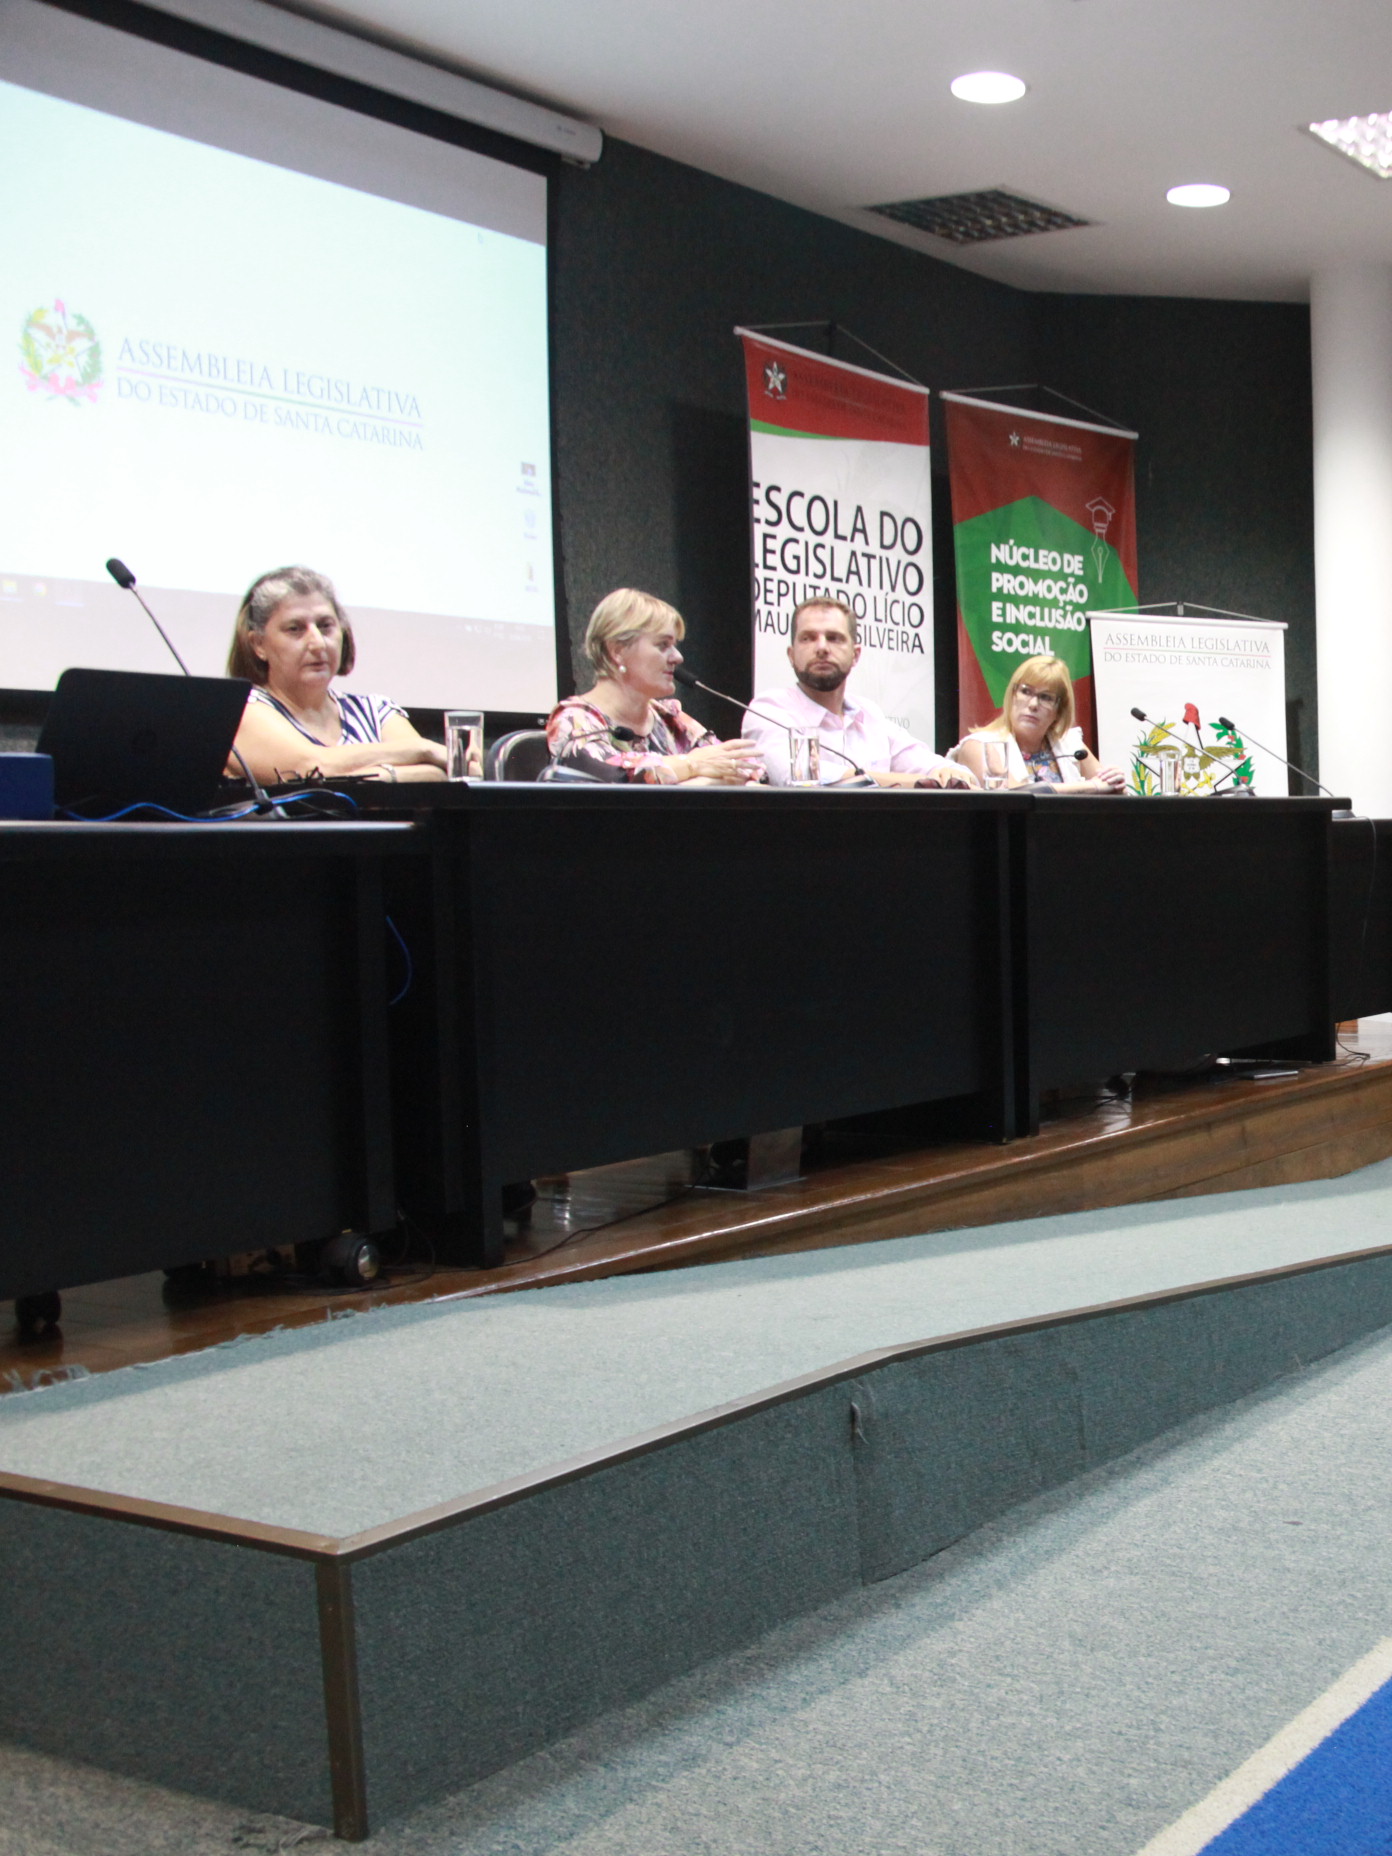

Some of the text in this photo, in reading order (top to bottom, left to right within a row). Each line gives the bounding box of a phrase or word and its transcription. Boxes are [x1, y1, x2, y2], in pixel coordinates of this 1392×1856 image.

[117, 337, 422, 419] ASSEMBLEIA LEGISLATIVA
[117, 376, 423, 451] DO ESTADO DE SANTA CATARINA
[879, 510, 924, 556] DO
[754, 532, 924, 596] EGISLATIVO
[990, 538, 1084, 576] NÚCLEO DE
[991, 571, 1089, 607] PROMOÇÃO
[874, 592, 925, 629] LÍCIO
[991, 601, 1087, 632] E INCLUSÃO
[991, 630, 1055, 657] SOCIAL
[1104, 651, 1272, 670] DO ESTADO DE SANTA CATARINA
[1105, 633, 1270, 654] ASSEMBLEIA LEGISLATIVA
